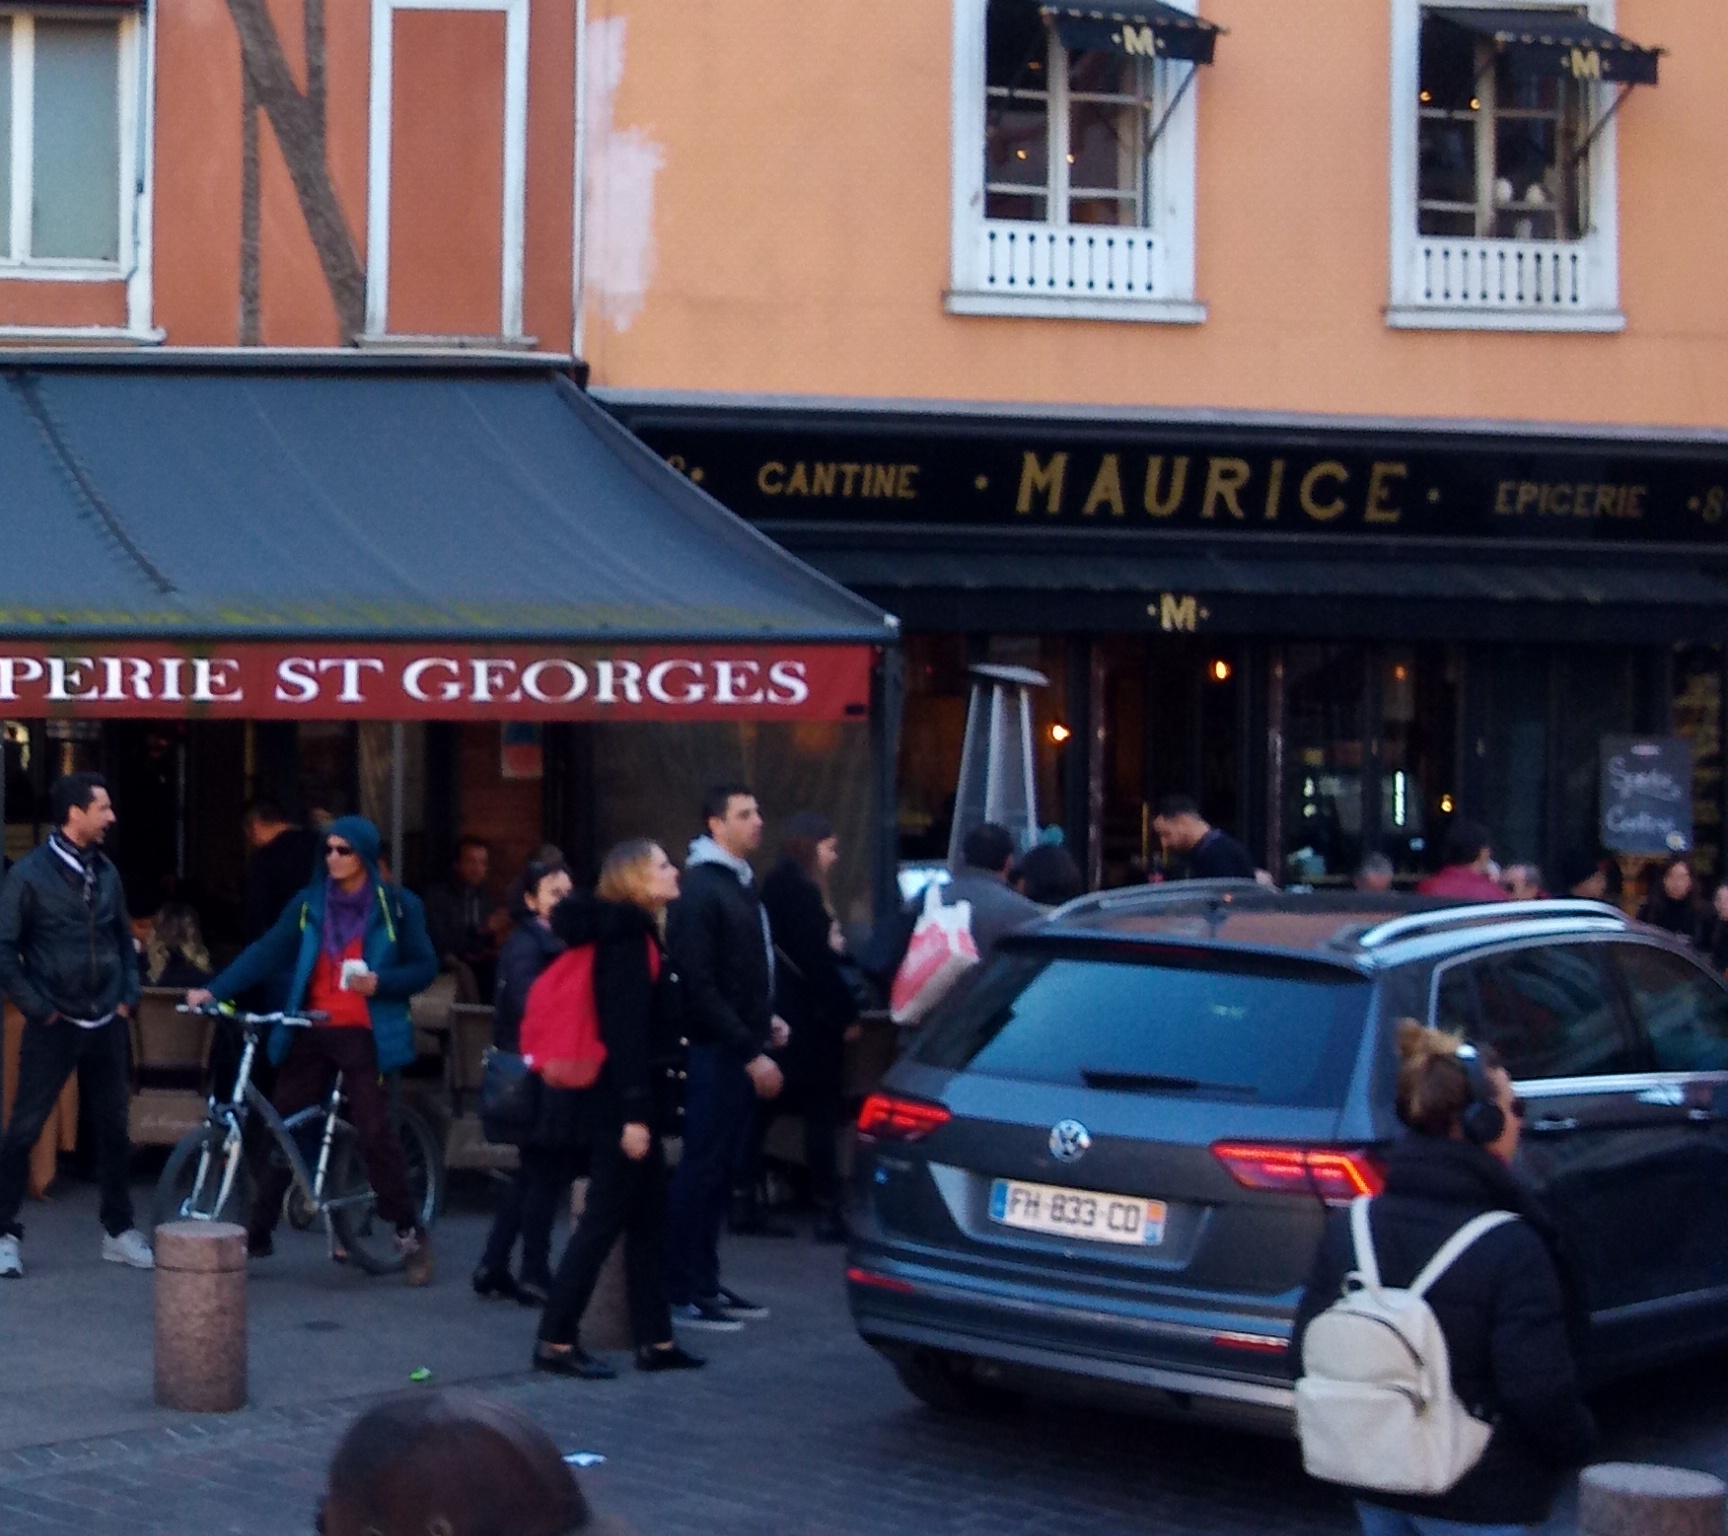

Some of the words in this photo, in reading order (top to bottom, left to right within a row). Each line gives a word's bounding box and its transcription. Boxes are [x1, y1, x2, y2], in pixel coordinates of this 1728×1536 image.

[1122, 24, 1157, 58] M
[1570, 47, 1602, 81] M
[757, 461, 920, 500] CANTINE
[1015, 450, 1408, 524] MAURICE
[1494, 480, 1647, 519] EPICERIE
[1160, 592, 1198, 633] M
[274, 658, 383, 703] ST
[401, 657, 810, 705] GEORGES
